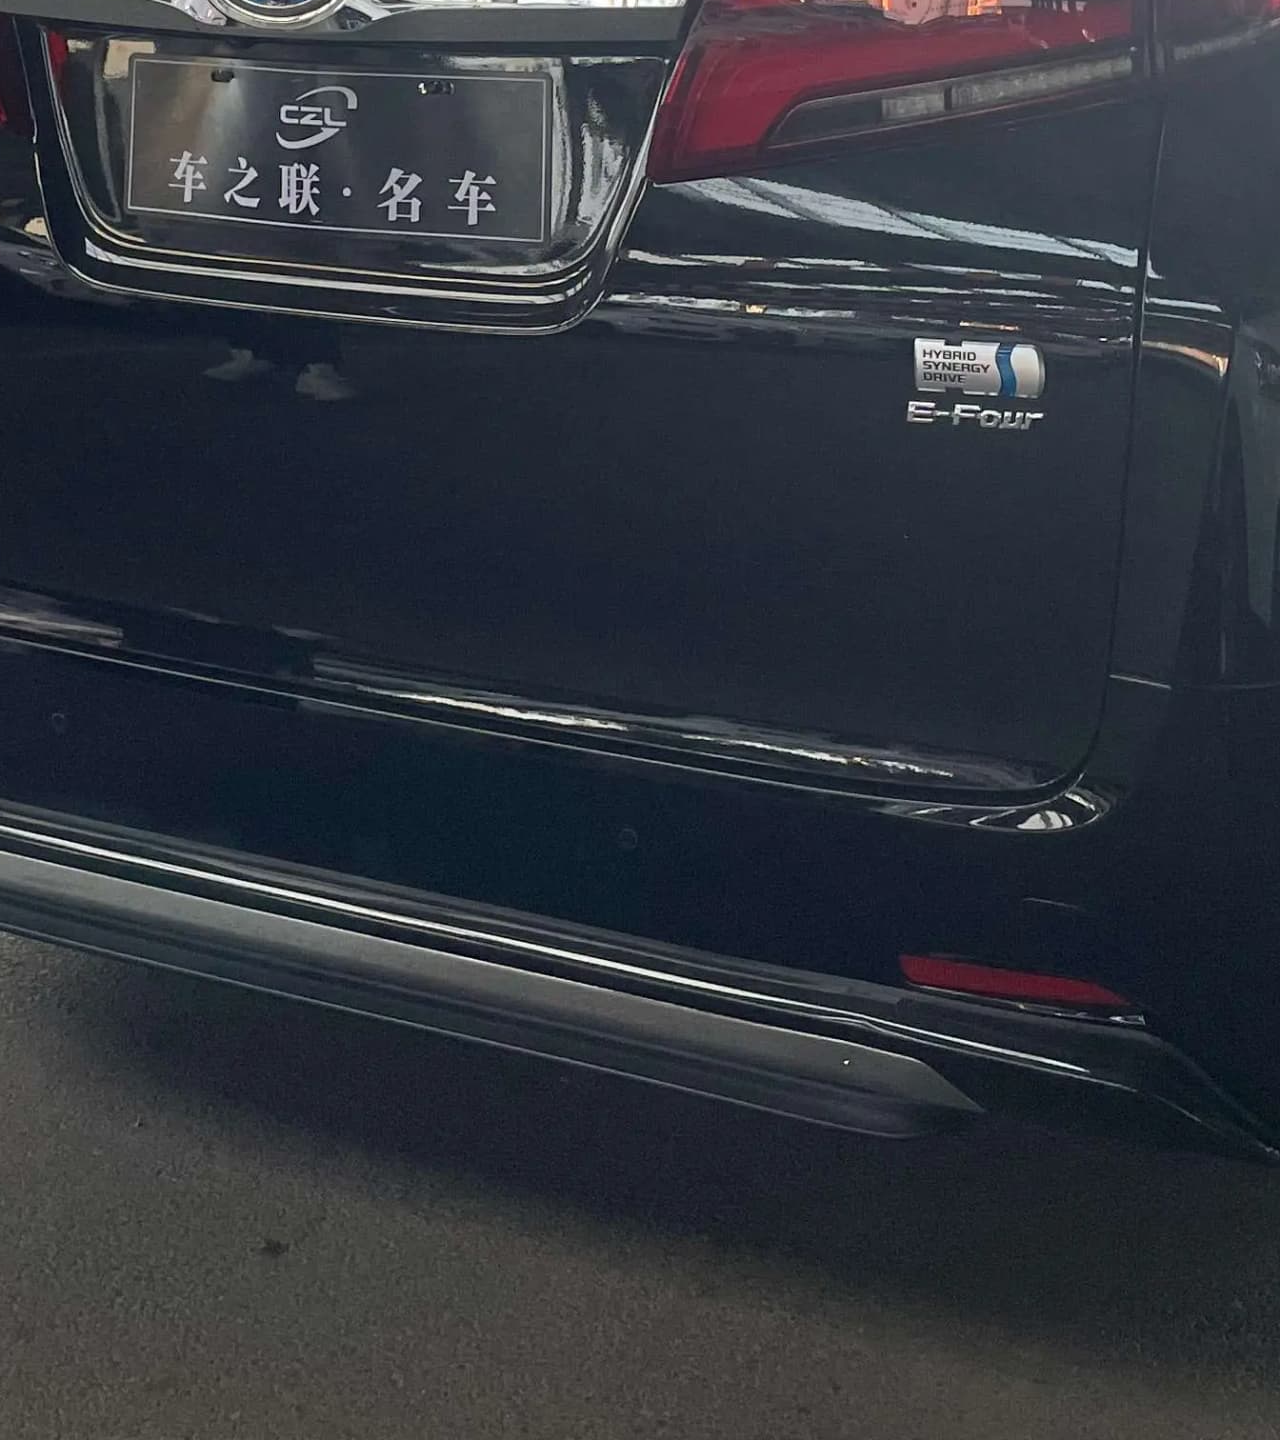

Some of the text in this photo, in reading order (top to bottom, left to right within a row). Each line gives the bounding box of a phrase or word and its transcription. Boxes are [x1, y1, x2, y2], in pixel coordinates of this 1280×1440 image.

[279, 103, 348, 127] CZL
[167, 150, 498, 227] 车之联·名车
[922, 348, 977, 361] HYBRID
[922, 359, 991, 374] SYNERGY
[922, 371, 967, 384] DRIVE
[906, 400, 1045, 430] E-Four
